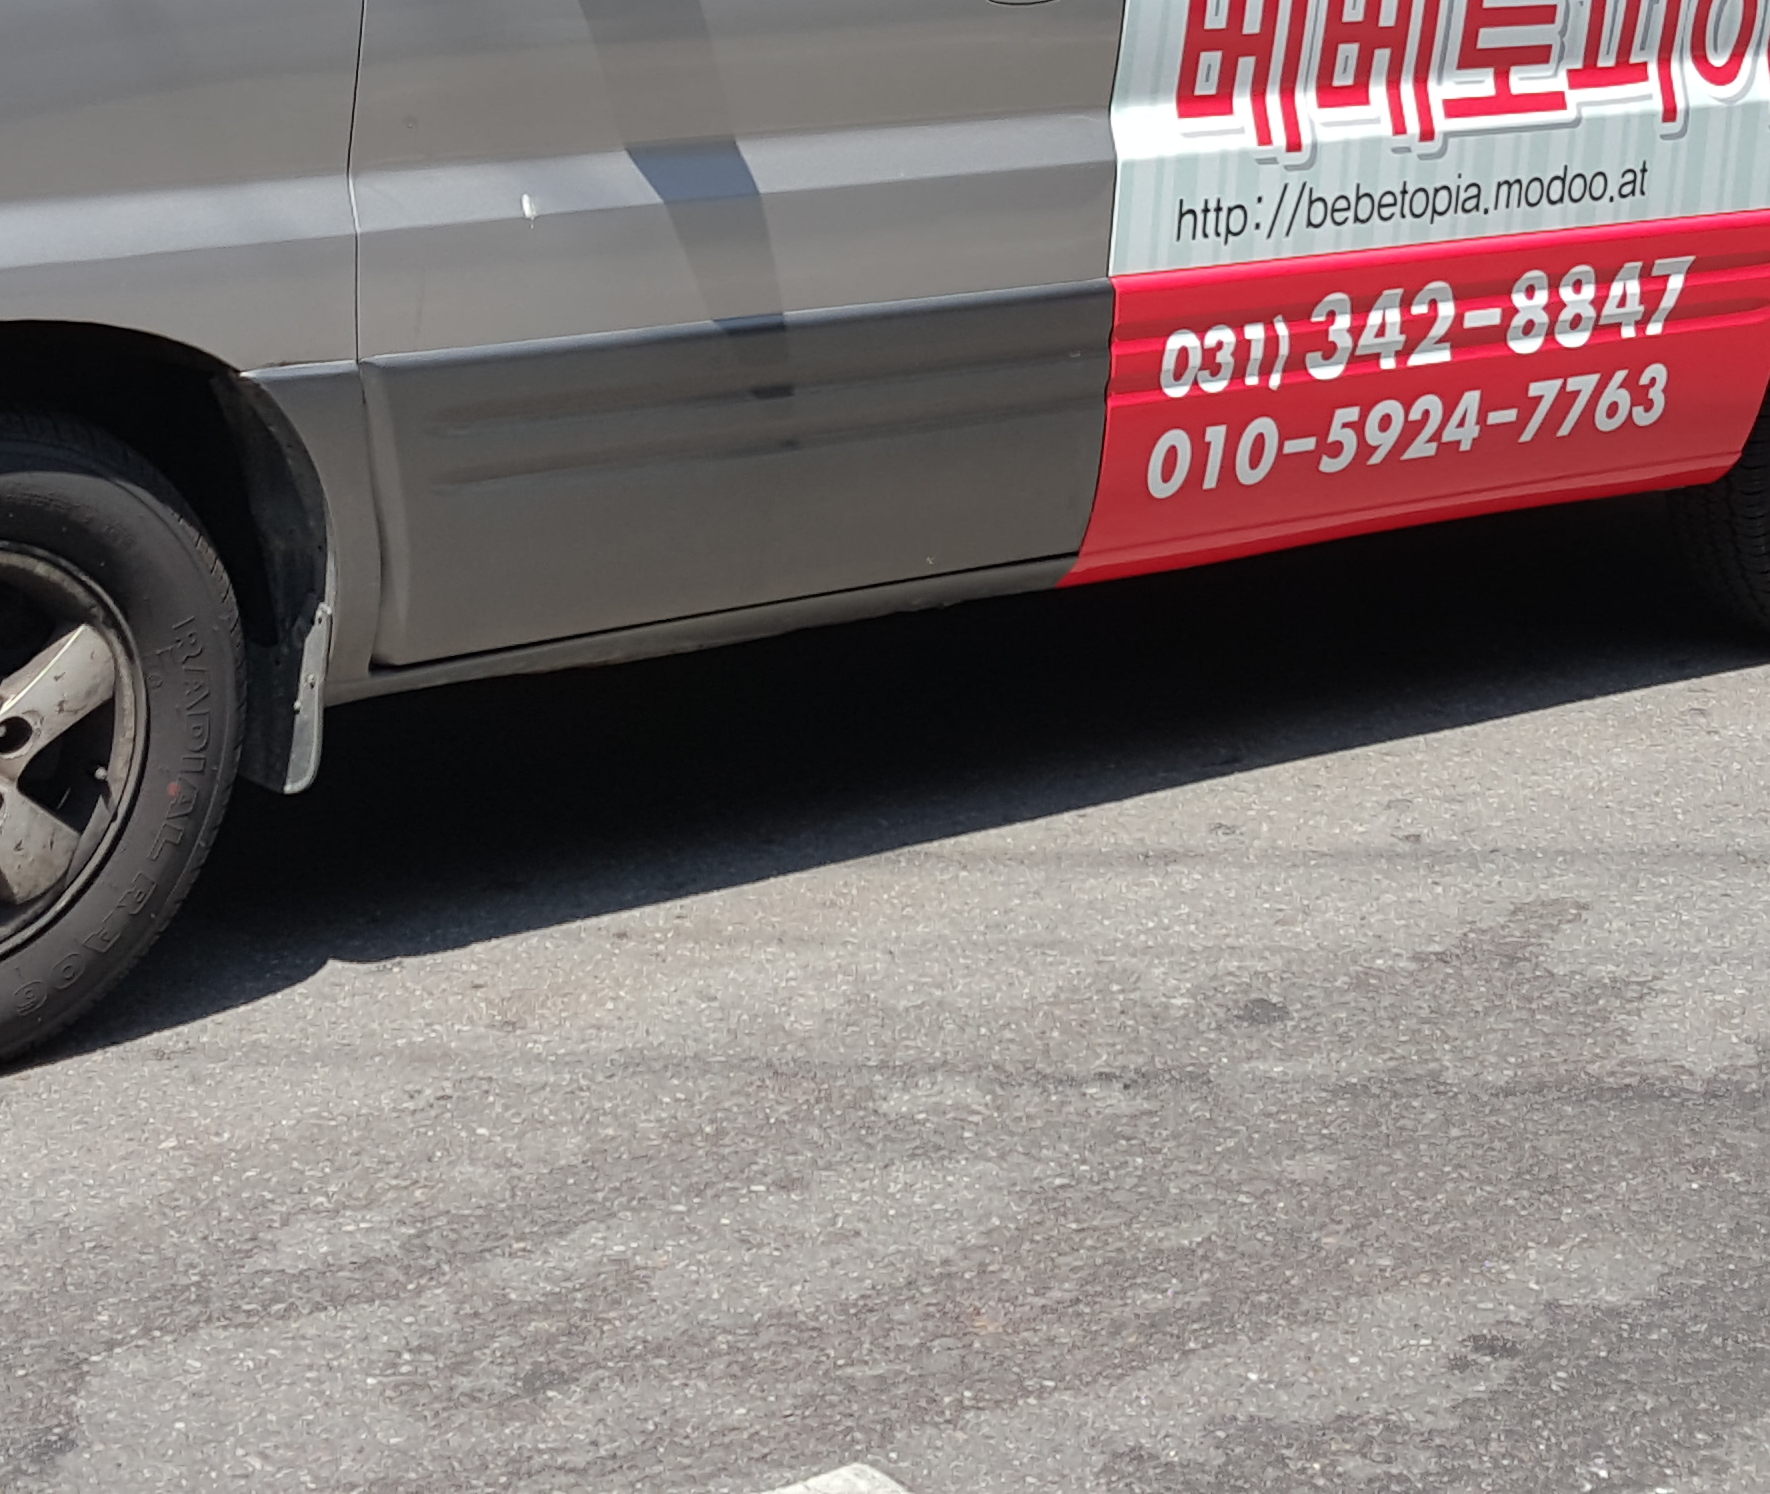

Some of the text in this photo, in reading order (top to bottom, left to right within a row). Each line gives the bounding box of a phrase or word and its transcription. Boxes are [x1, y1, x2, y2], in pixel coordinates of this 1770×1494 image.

[1175, 159, 1650, 243] http://bebetopia.modoo.at
[1160, 255, 1696, 398] 031) 342-8847
[1146, 363, 1669, 499] 010-5924-7763
